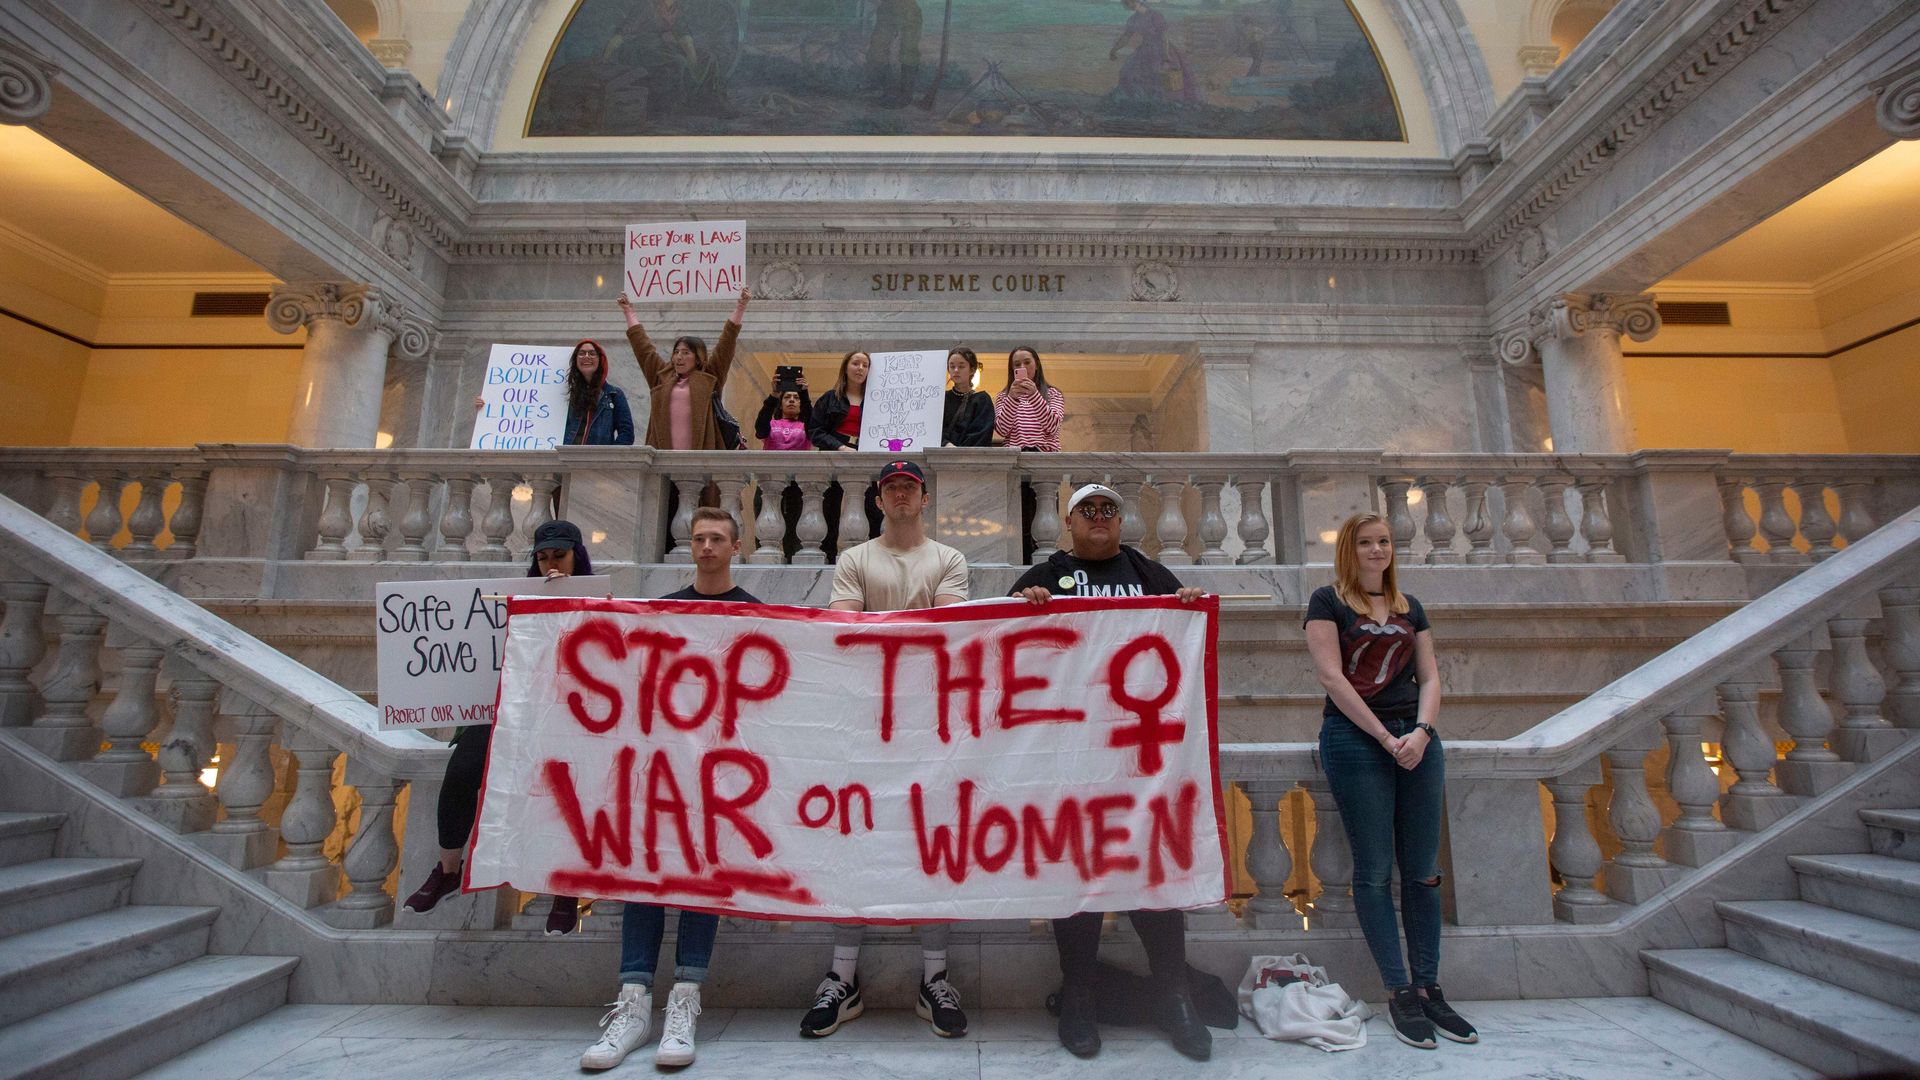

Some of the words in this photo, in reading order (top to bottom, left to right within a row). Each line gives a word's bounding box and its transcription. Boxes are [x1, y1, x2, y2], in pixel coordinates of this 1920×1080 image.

[631, 231, 662, 250] KEEP
[665, 230, 695, 247] YOUR
[700, 230, 742, 246] LAWS
[640, 254, 666, 268] OUT
[672, 252, 691, 265] OF
[699, 251, 719, 264] MY
[627, 265, 742, 298] VAGINA!!
[871, 274, 980, 292] SUPREME
[992, 274, 1066, 292] COURT
[510, 352, 549, 367] OUR
[883, 354, 922, 373] KEEP
[488, 366, 566, 385] BODIES
[503, 387, 539, 404] OUR
[871, 385, 941, 402] OPINIONS
[485, 403, 550, 419] LIVES
[880, 401, 905, 414] OUT
[498, 418, 534, 434] OUR
[868, 422, 928, 439] UTERUS
[379, 593, 454, 633] Safe
[406, 635, 477, 677] Save
[558, 617, 791, 740] STOP
[834, 627, 1086, 743] THE
[430, 704, 455, 722] OUR
[543, 745, 774, 873] WAR
[797, 783, 875, 834] on
[909, 778, 1199, 887] WOMEN
